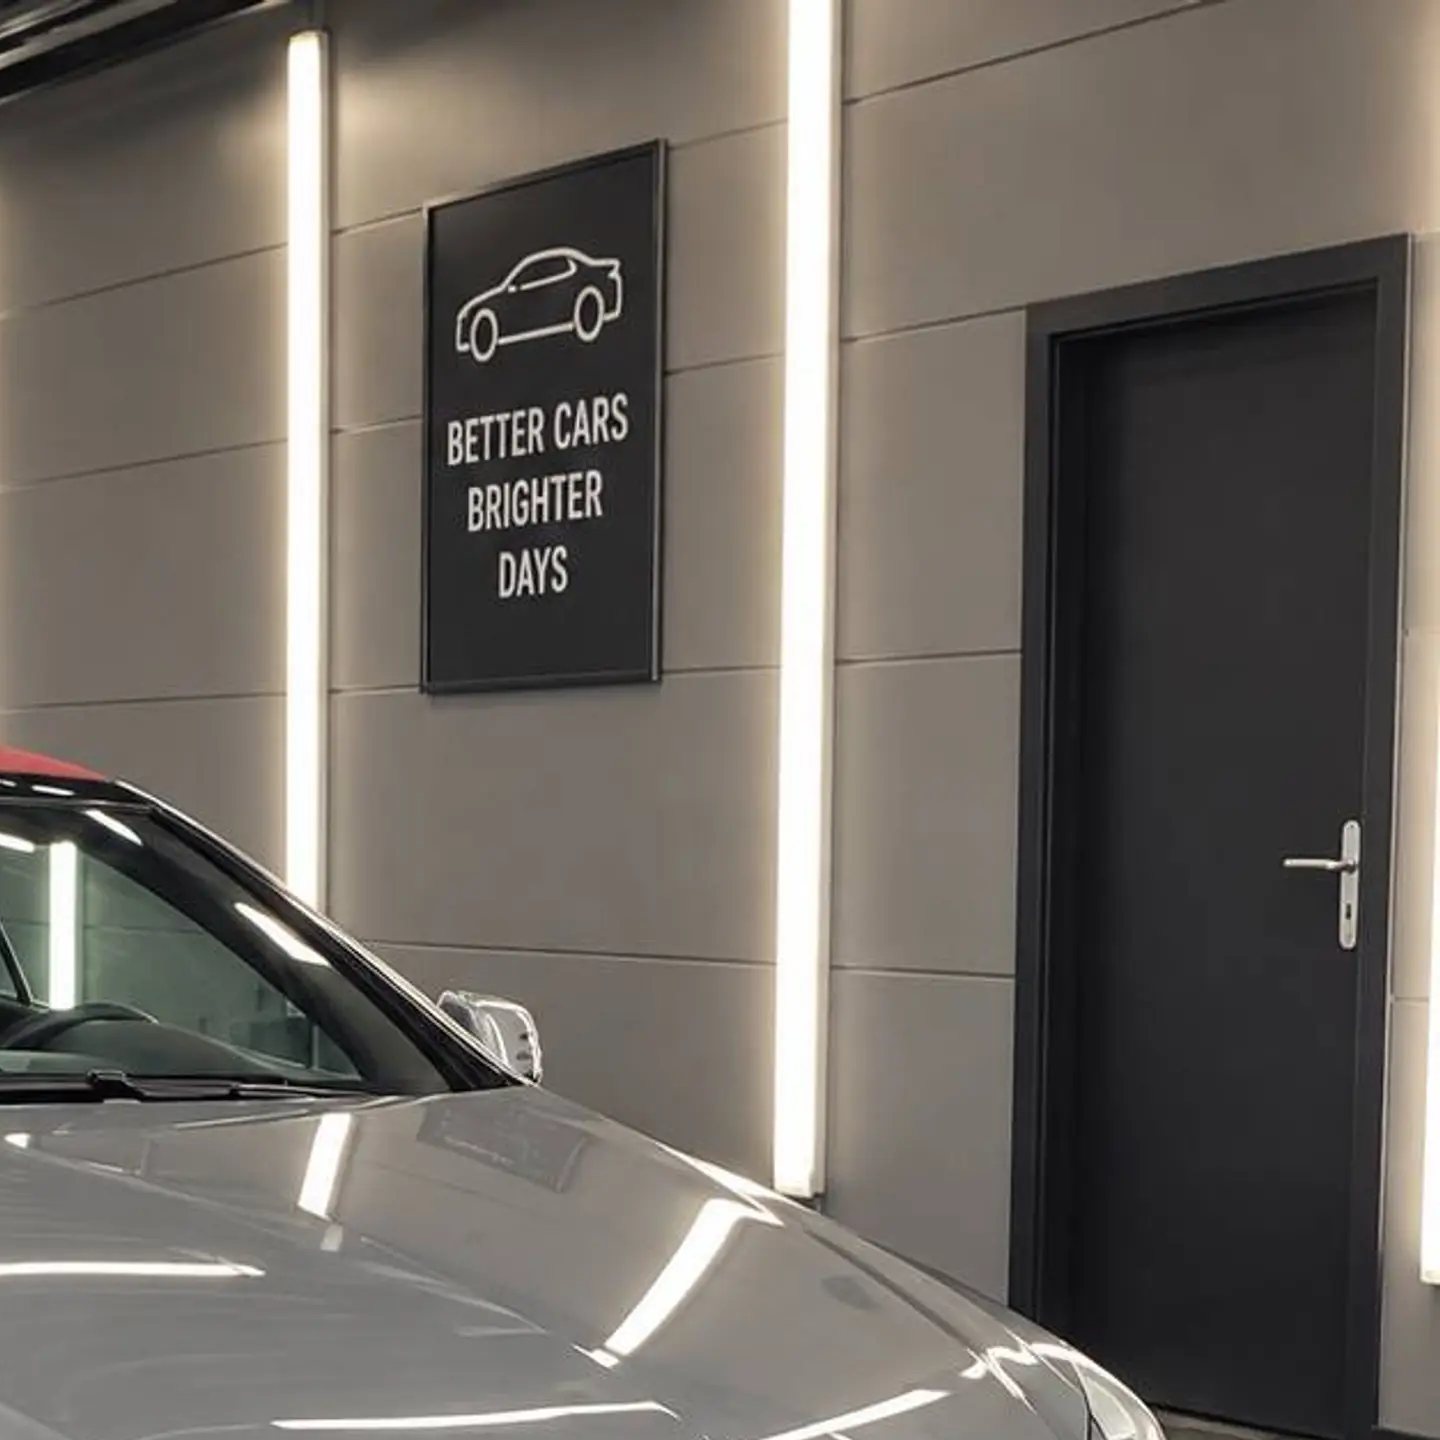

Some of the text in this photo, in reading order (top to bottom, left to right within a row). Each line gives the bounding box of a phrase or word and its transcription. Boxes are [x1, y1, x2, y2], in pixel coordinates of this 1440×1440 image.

[447, 392, 629, 466] BETTER CARS
[467, 469, 603, 533] BRIGHTER
[498, 545, 568, 599] DAYS
